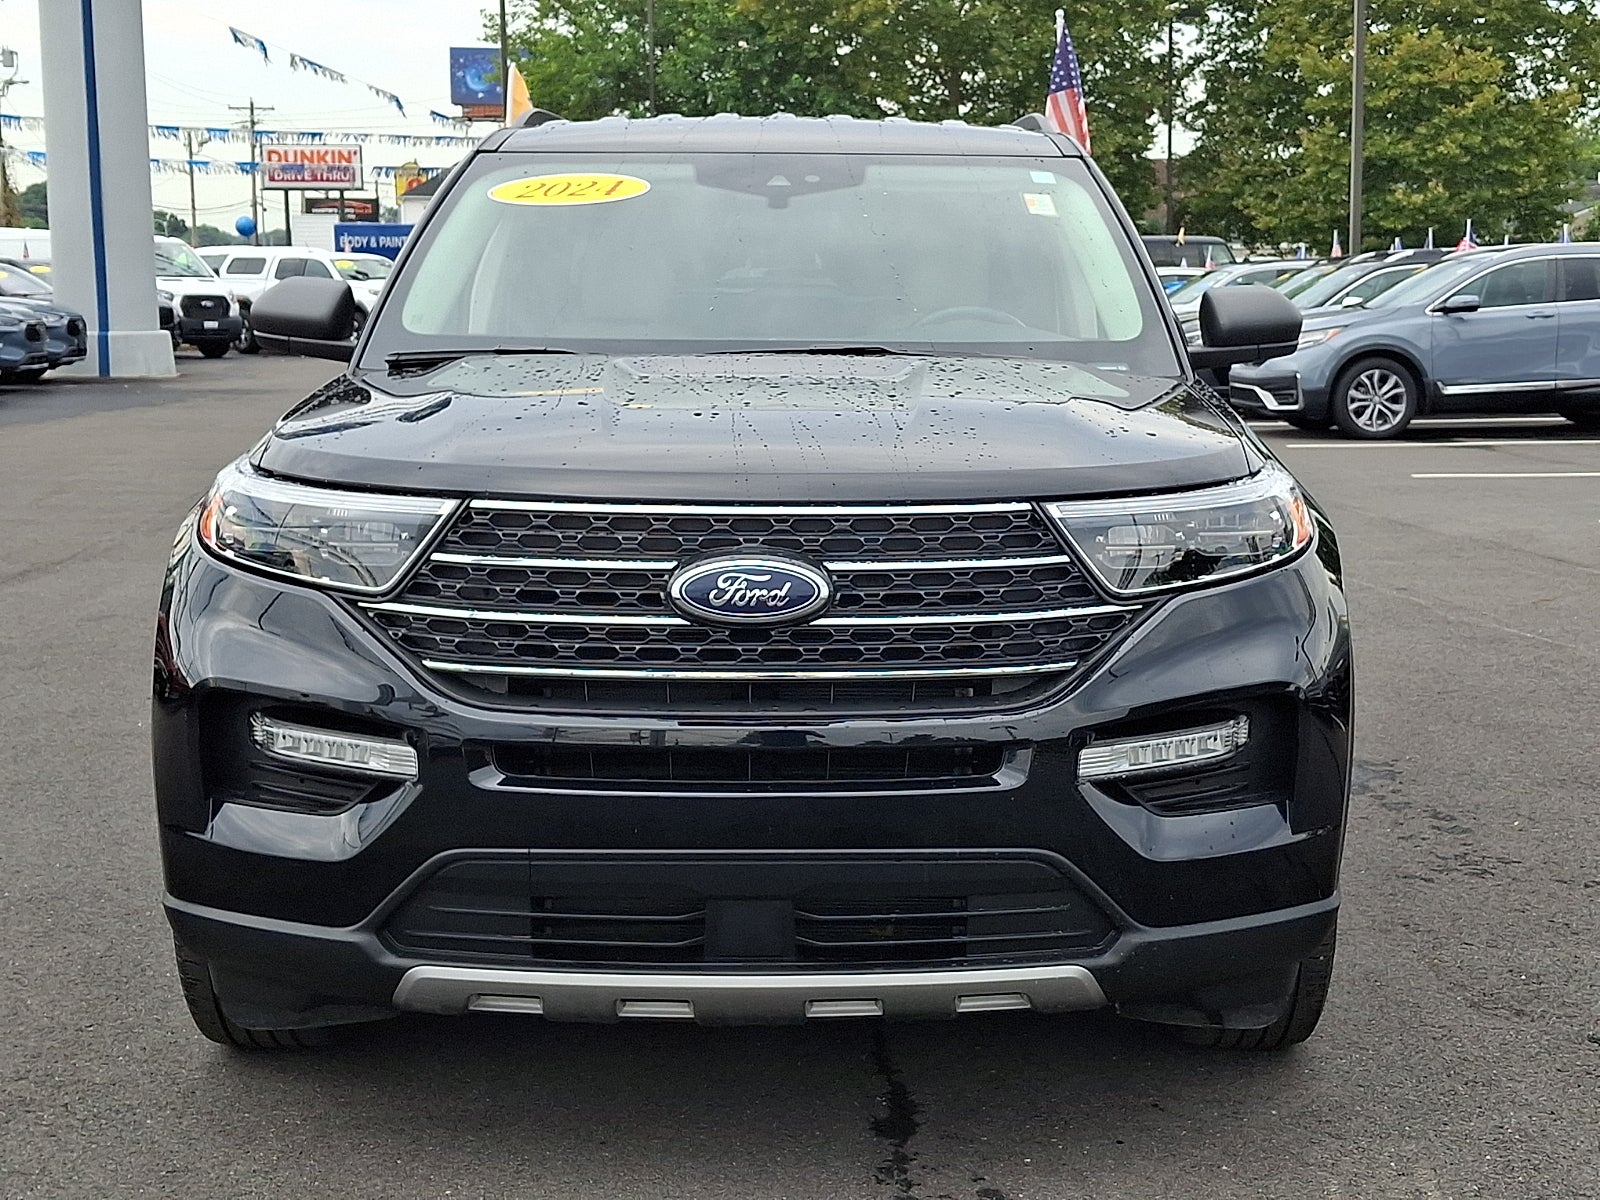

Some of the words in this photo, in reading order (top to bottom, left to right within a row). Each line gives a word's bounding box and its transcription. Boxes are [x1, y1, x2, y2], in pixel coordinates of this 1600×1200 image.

[267, 149, 357, 163] DUNKIN'
[316, 168, 350, 181] THRU
[515, 180, 624, 199] 2024
[340, 235, 369, 248] BODY
[370, 235, 378, 248] &
[708, 572, 792, 607] Ford
